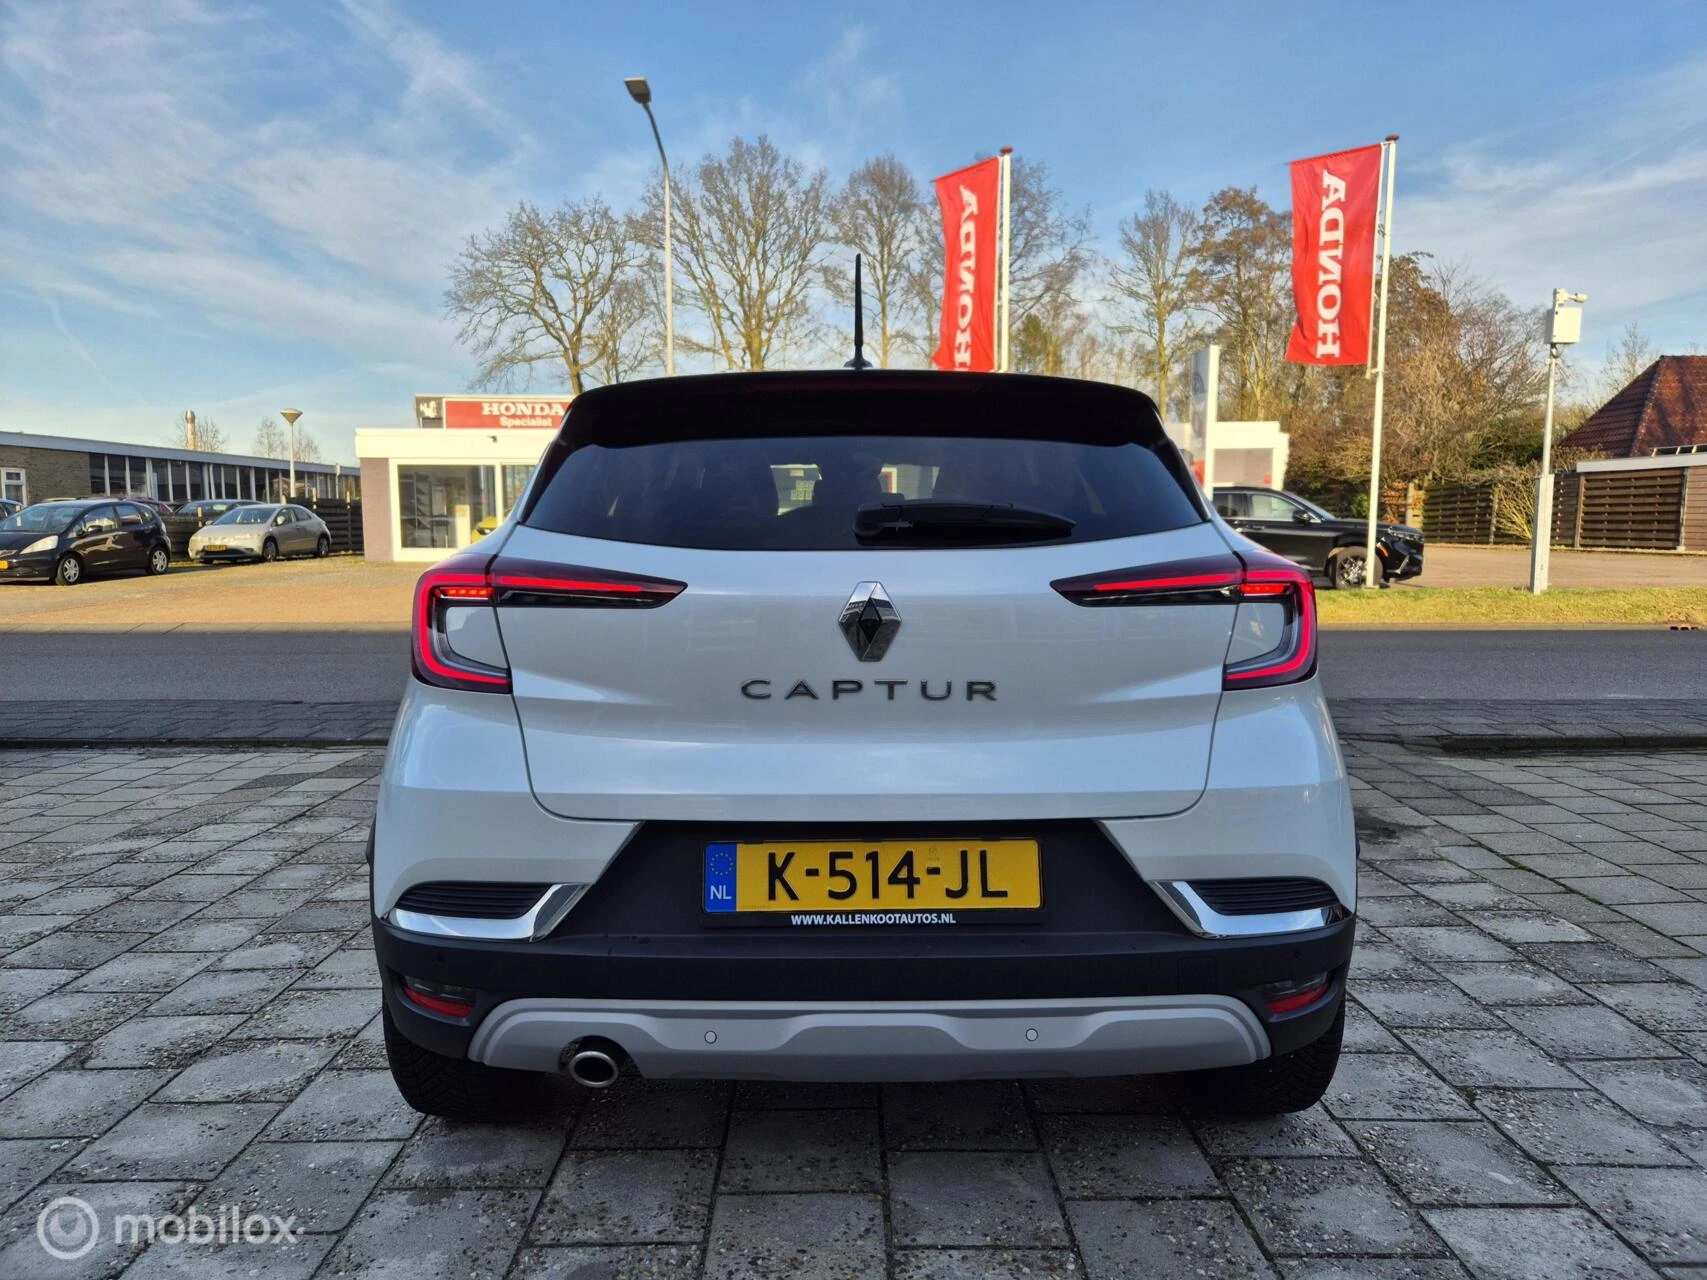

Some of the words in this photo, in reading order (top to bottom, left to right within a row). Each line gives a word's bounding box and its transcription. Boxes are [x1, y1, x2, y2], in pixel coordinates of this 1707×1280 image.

[481, 402, 565, 416] HONDA
[499, 416, 552, 428] Specialist
[740, 679, 998, 702] CAPTUR
[709, 884, 732, 900] NL
[767, 849, 1008, 902] K-514-JL
[790, 913, 957, 926] WWW.KALLENKOOTAUTOS.NL
